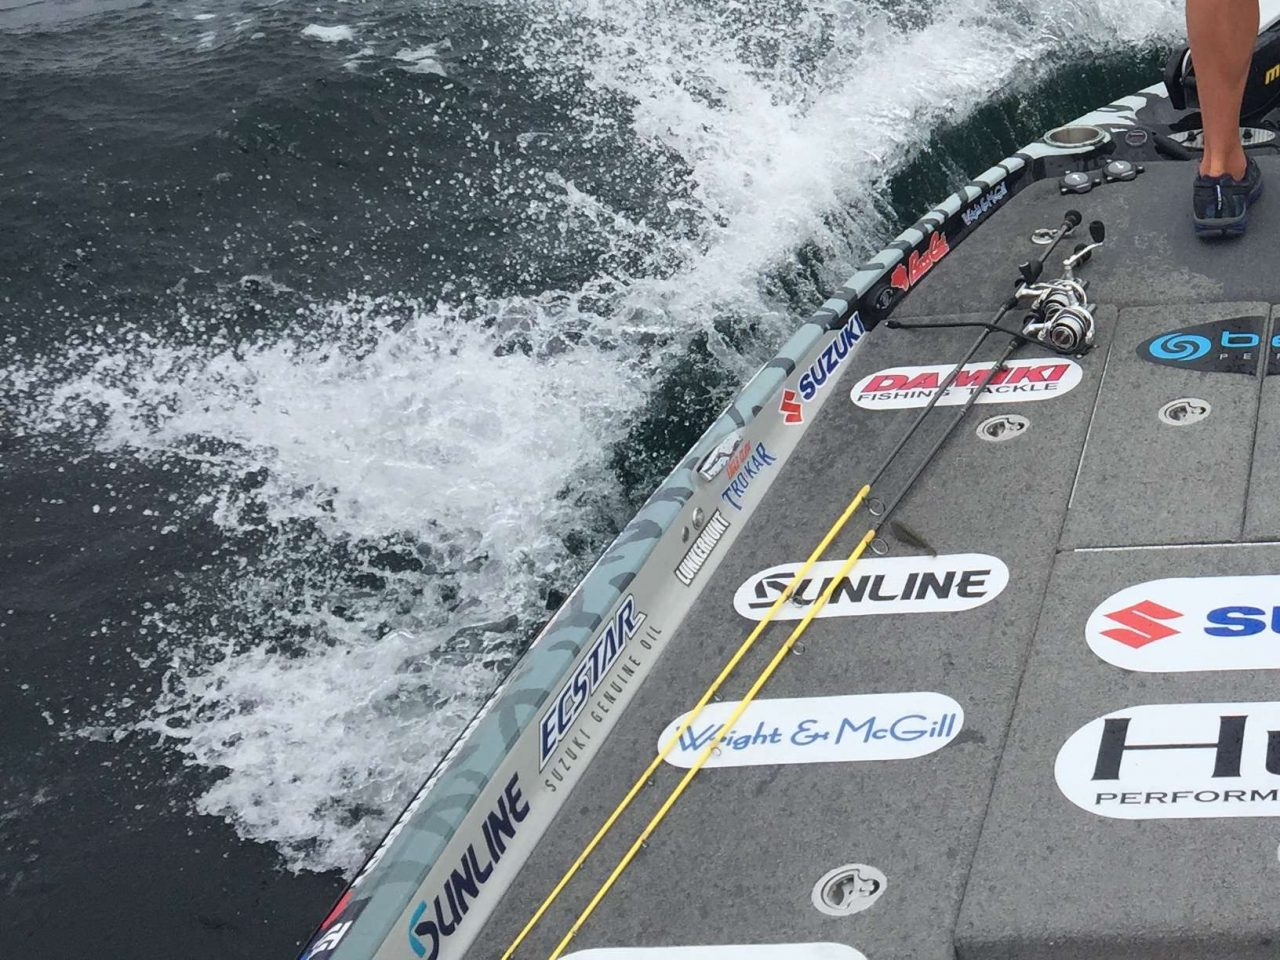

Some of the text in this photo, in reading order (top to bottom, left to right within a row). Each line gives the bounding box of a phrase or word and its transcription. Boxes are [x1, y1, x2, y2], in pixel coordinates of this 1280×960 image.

[799, 312, 866, 401] SUZUKI
[857, 382, 1058, 402] FISHING TACKLE
[721, 442, 777, 511] TROKAR
[748, 570, 991, 609] SUNLINE
[540, 596, 646, 770] ECSTAR
[545, 624, 662, 792] SUZUKI GENUINE OIL
[677, 721, 782, 751] Wight
[835, 713, 956, 744] McGill
[407, 771, 531, 960] SUNLINE
